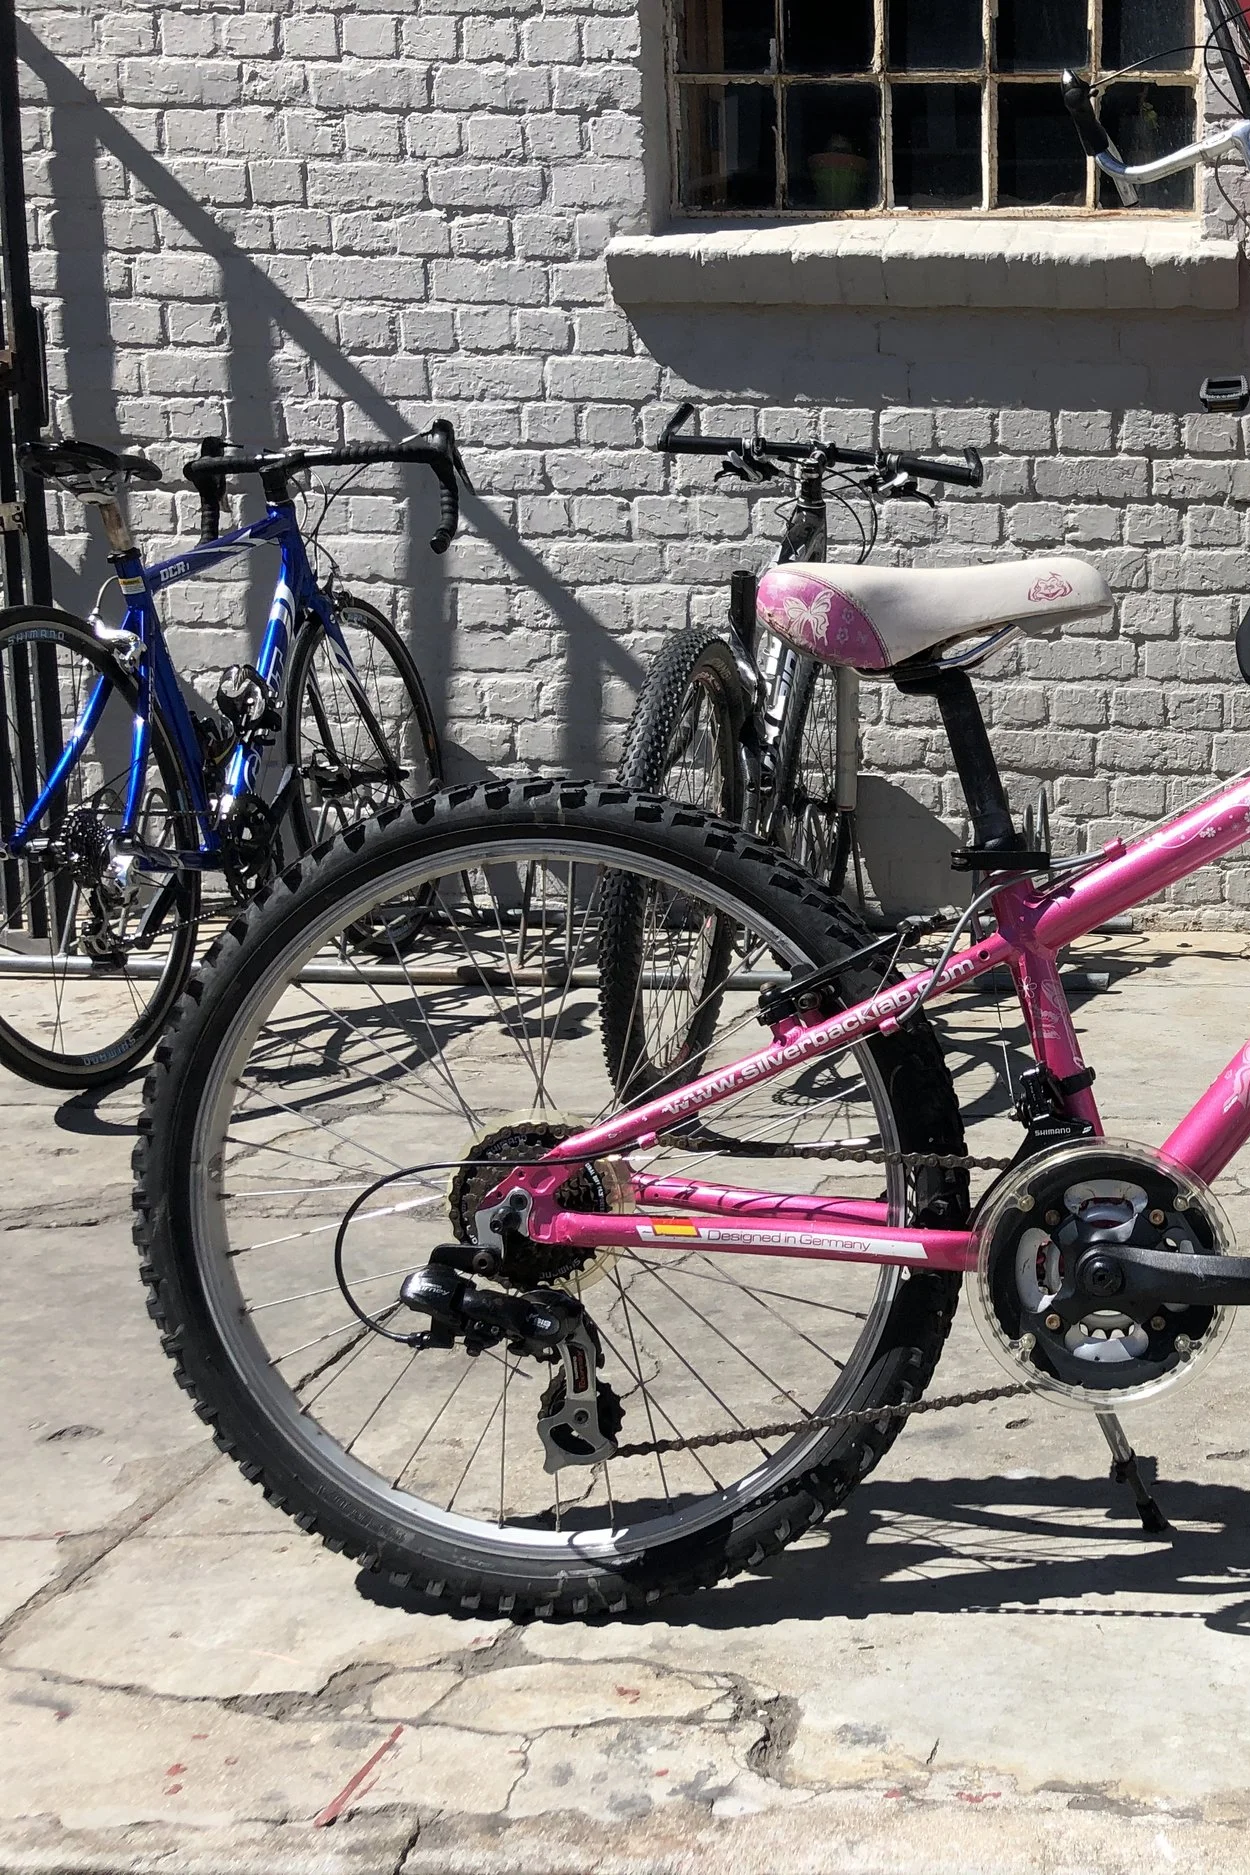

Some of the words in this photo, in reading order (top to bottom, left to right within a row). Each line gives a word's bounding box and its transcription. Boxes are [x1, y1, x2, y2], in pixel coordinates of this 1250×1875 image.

[7, 629, 65, 647] SHIMANO
[1034, 1126, 1071, 1137] SHIMANO
[706, 1229, 782, 1246] Designed
[783, 1233, 798, 1245] in
[799, 1233, 872, 1252] Germany
